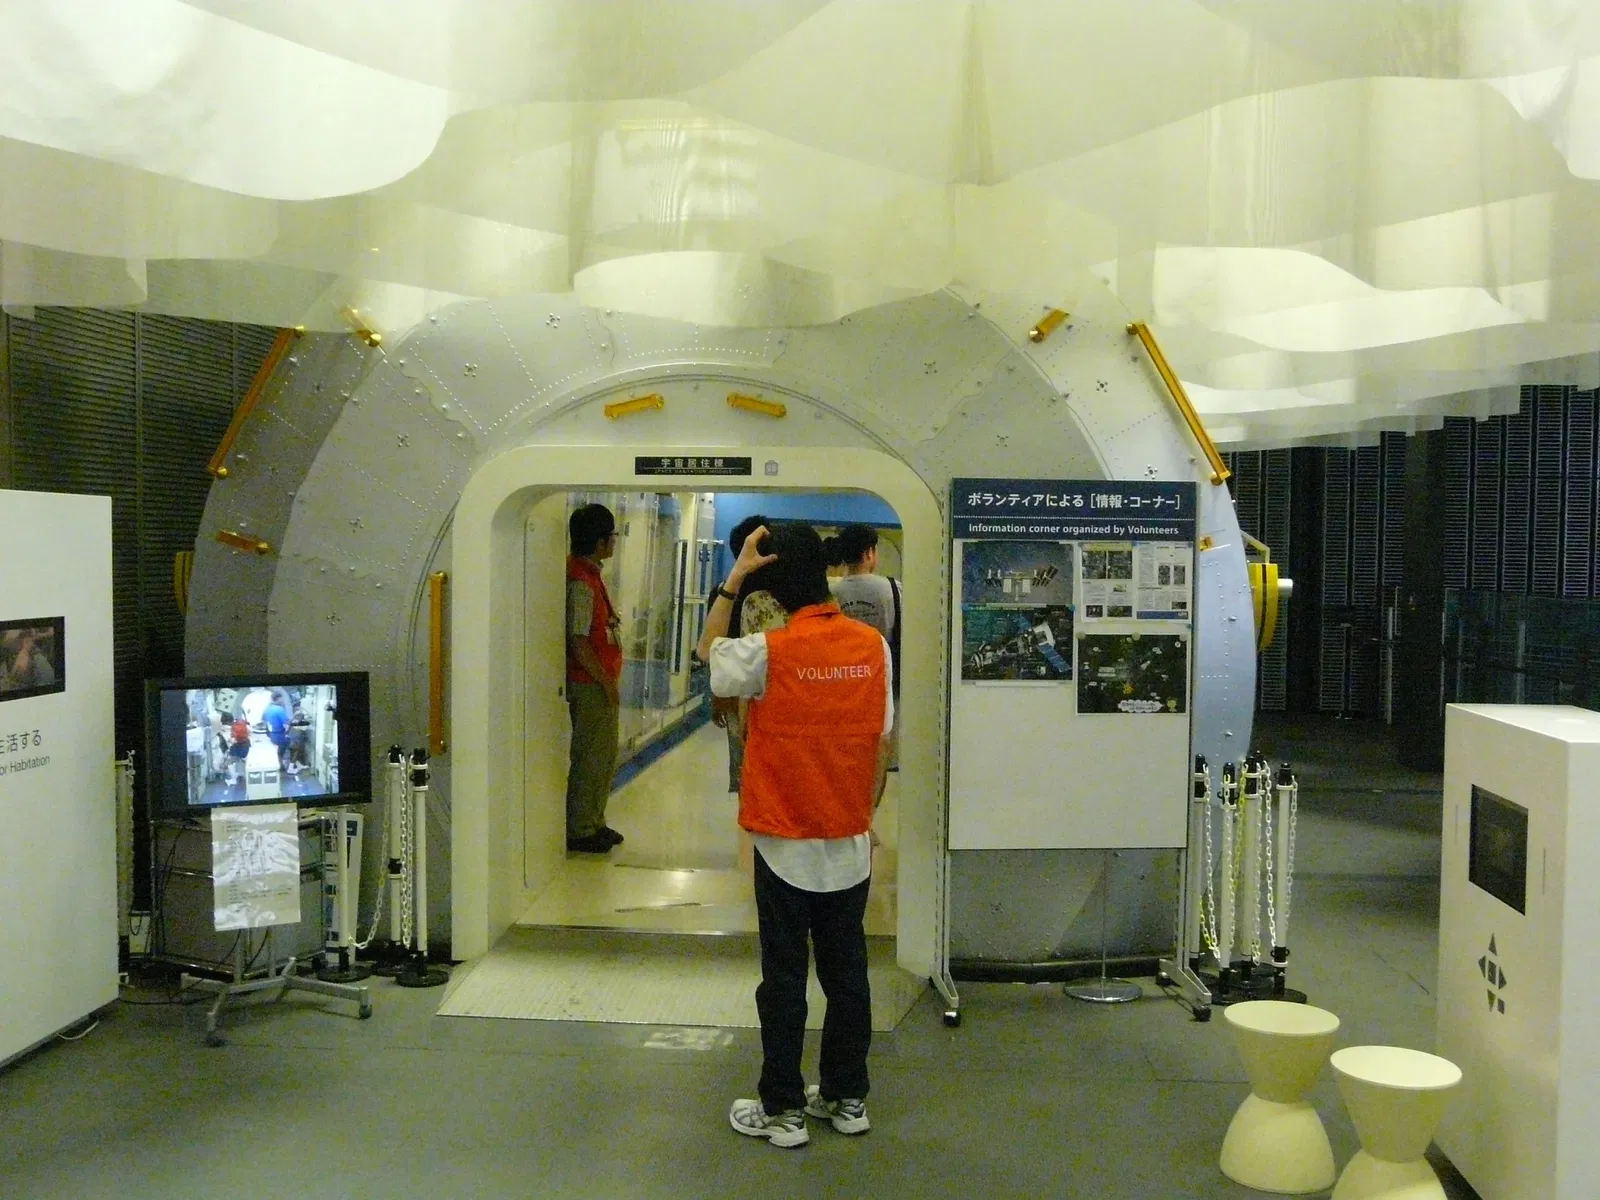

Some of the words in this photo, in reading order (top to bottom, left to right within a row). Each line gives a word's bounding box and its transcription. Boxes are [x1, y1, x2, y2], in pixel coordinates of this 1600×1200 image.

[968, 523, 1026, 533] Information
[1029, 525, 1060, 534] corner
[1062, 524, 1110, 536] organized
[1113, 524, 1125, 536] by
[1127, 525, 1179, 535] Volunteers
[796, 665, 872, 680] VOLUNTEER
[10, 756, 51, 773] Habitation
